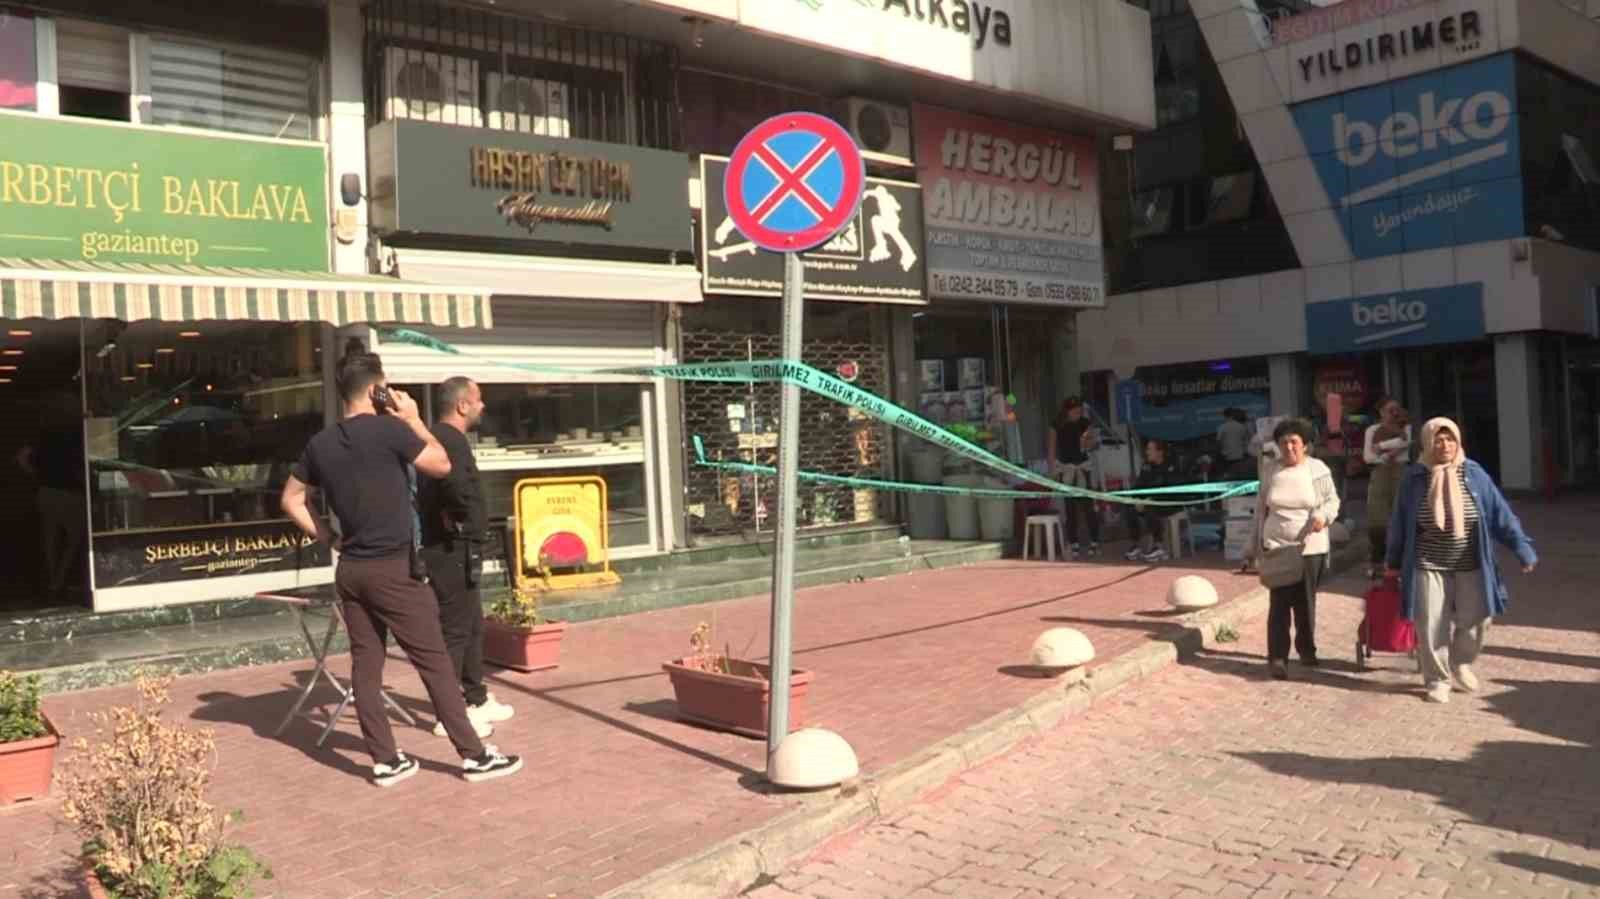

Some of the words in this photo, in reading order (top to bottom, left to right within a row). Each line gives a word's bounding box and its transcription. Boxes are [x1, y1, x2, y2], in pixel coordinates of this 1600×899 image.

[1298, 10, 1481, 82] YILDIRIMER
[1332, 90, 1511, 168] beko
[470, 146, 545, 191] HASAN
[941, 127, 1081, 190] HERGÜL
[163, 175, 312, 223] BAKLAVA
[81, 229, 200, 262] gaziantep
[1352, 297, 1427, 326] beko
